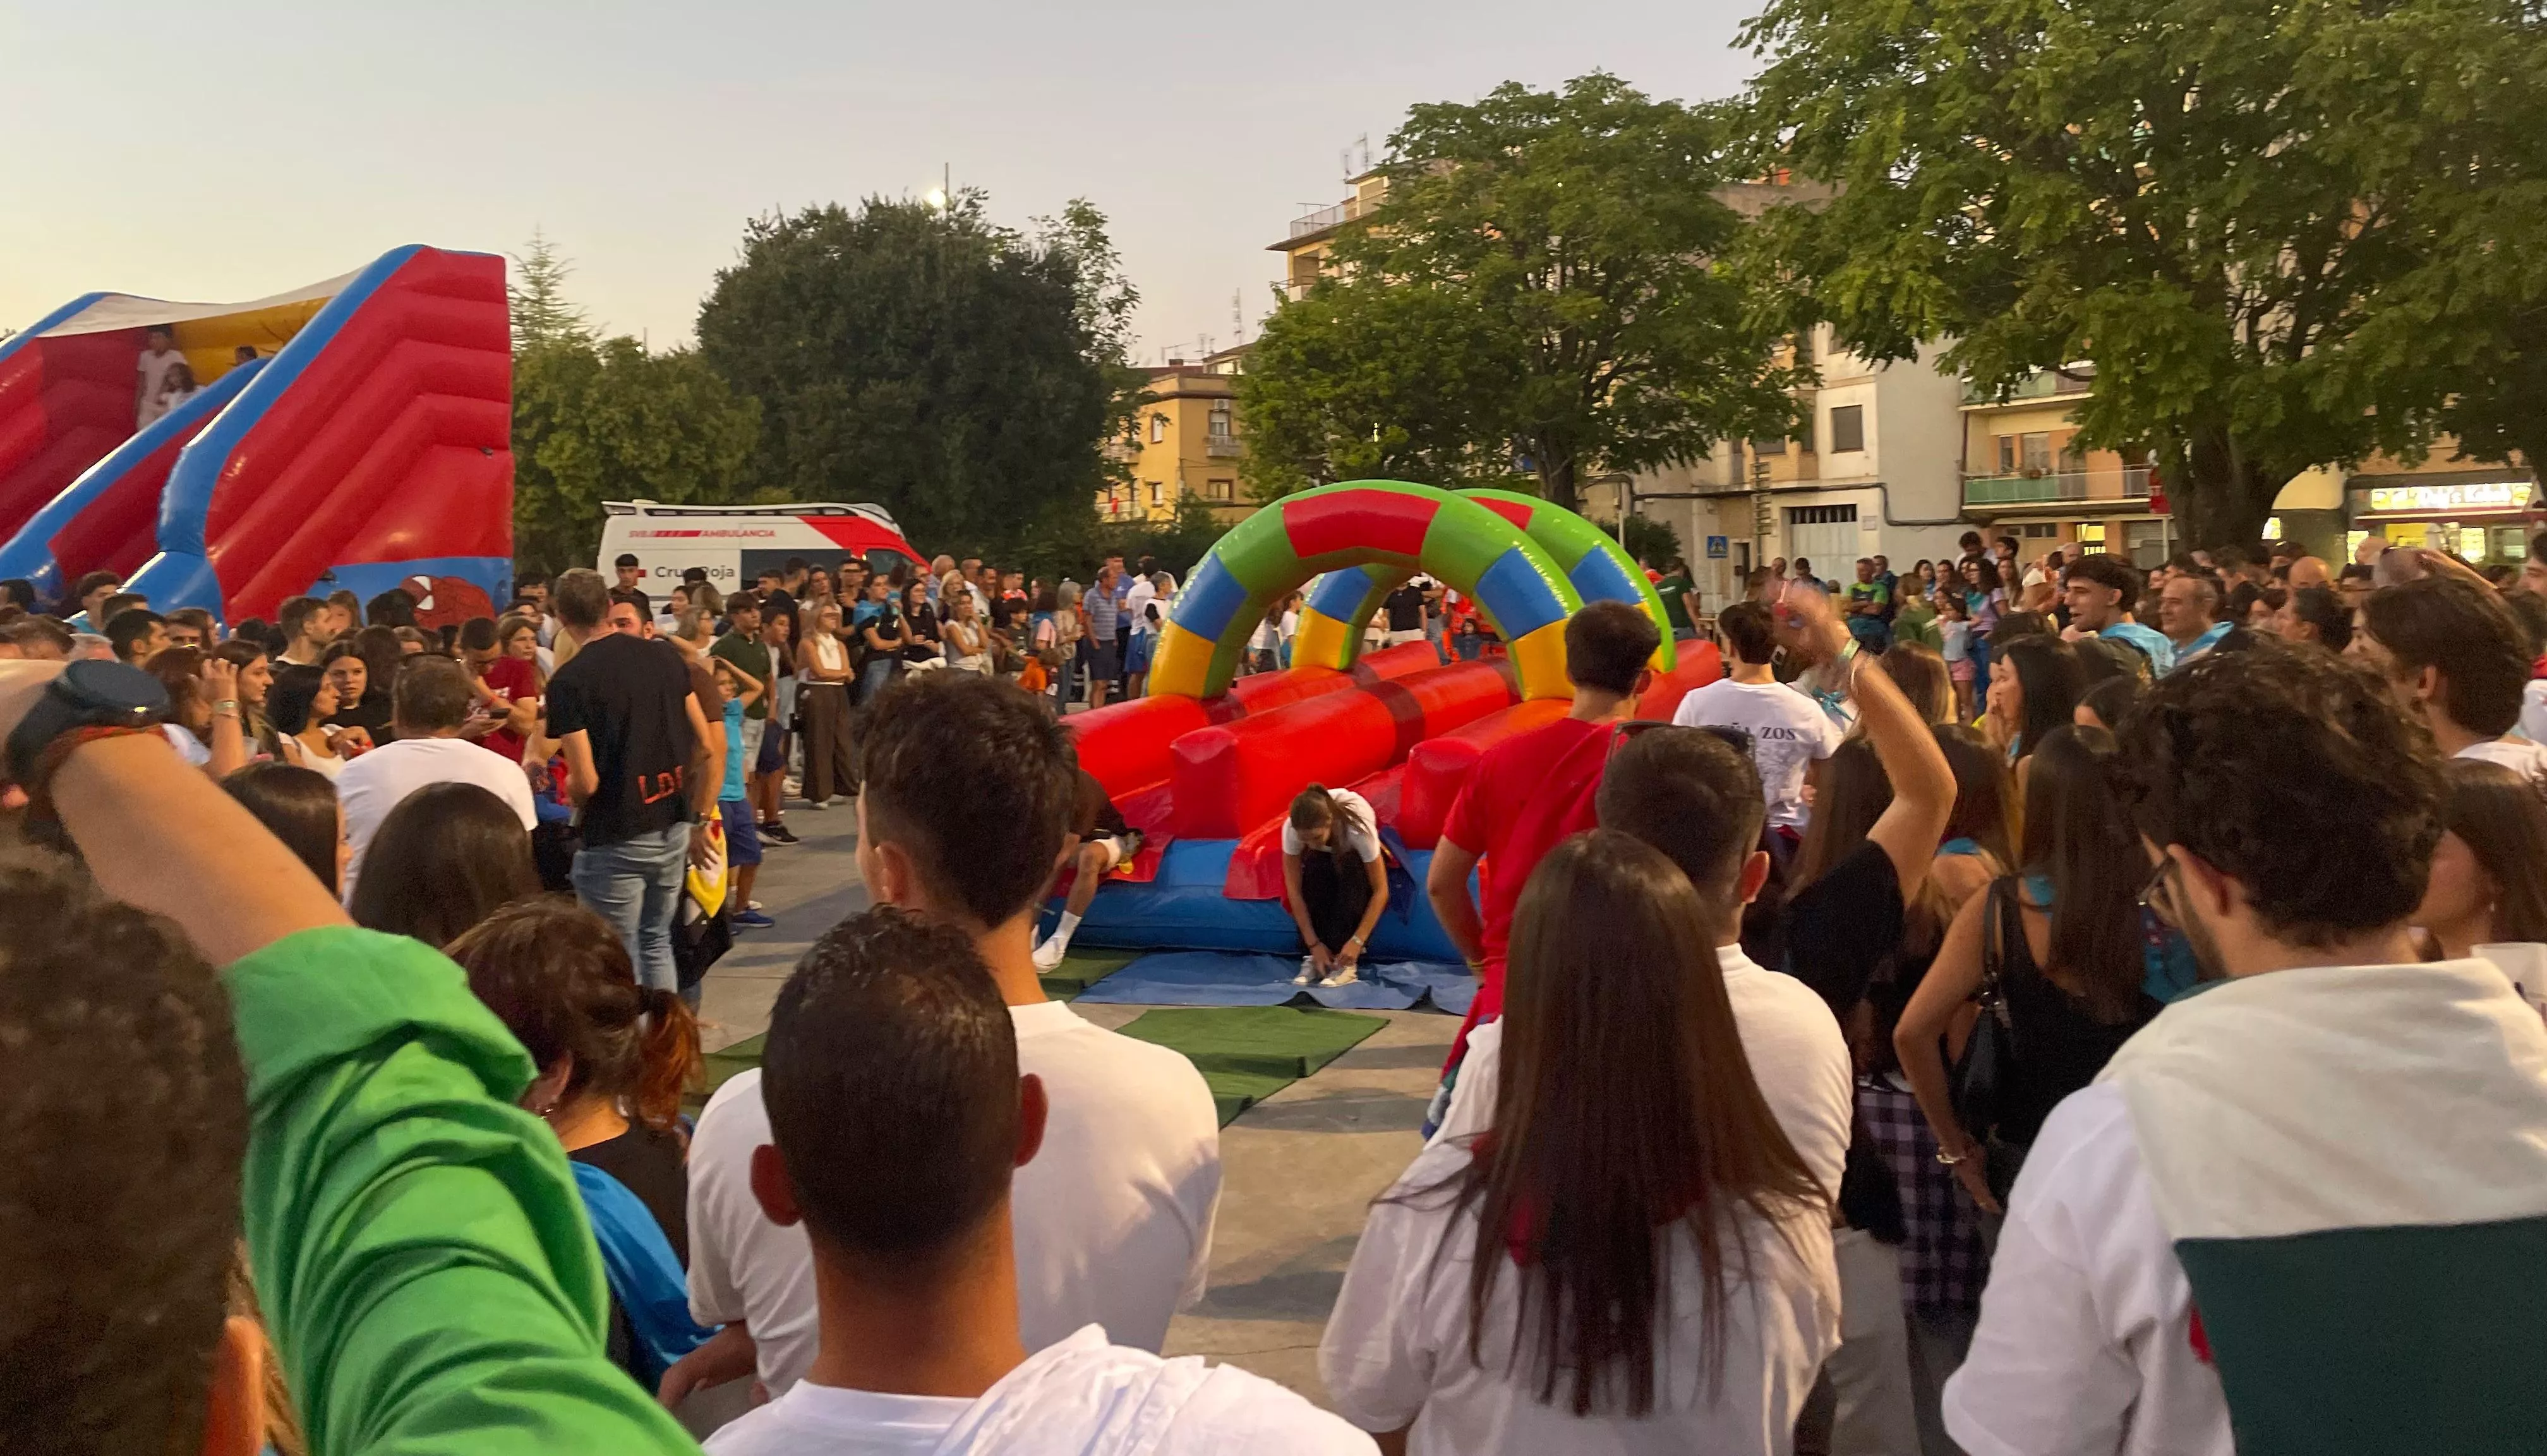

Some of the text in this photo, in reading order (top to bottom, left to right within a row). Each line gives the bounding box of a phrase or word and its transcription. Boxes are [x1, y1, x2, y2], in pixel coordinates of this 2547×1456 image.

[701, 529, 775, 538] AMBULANCIA
[655, 566, 686, 578] Cru
[1761, 726, 1796, 740] ZOS
